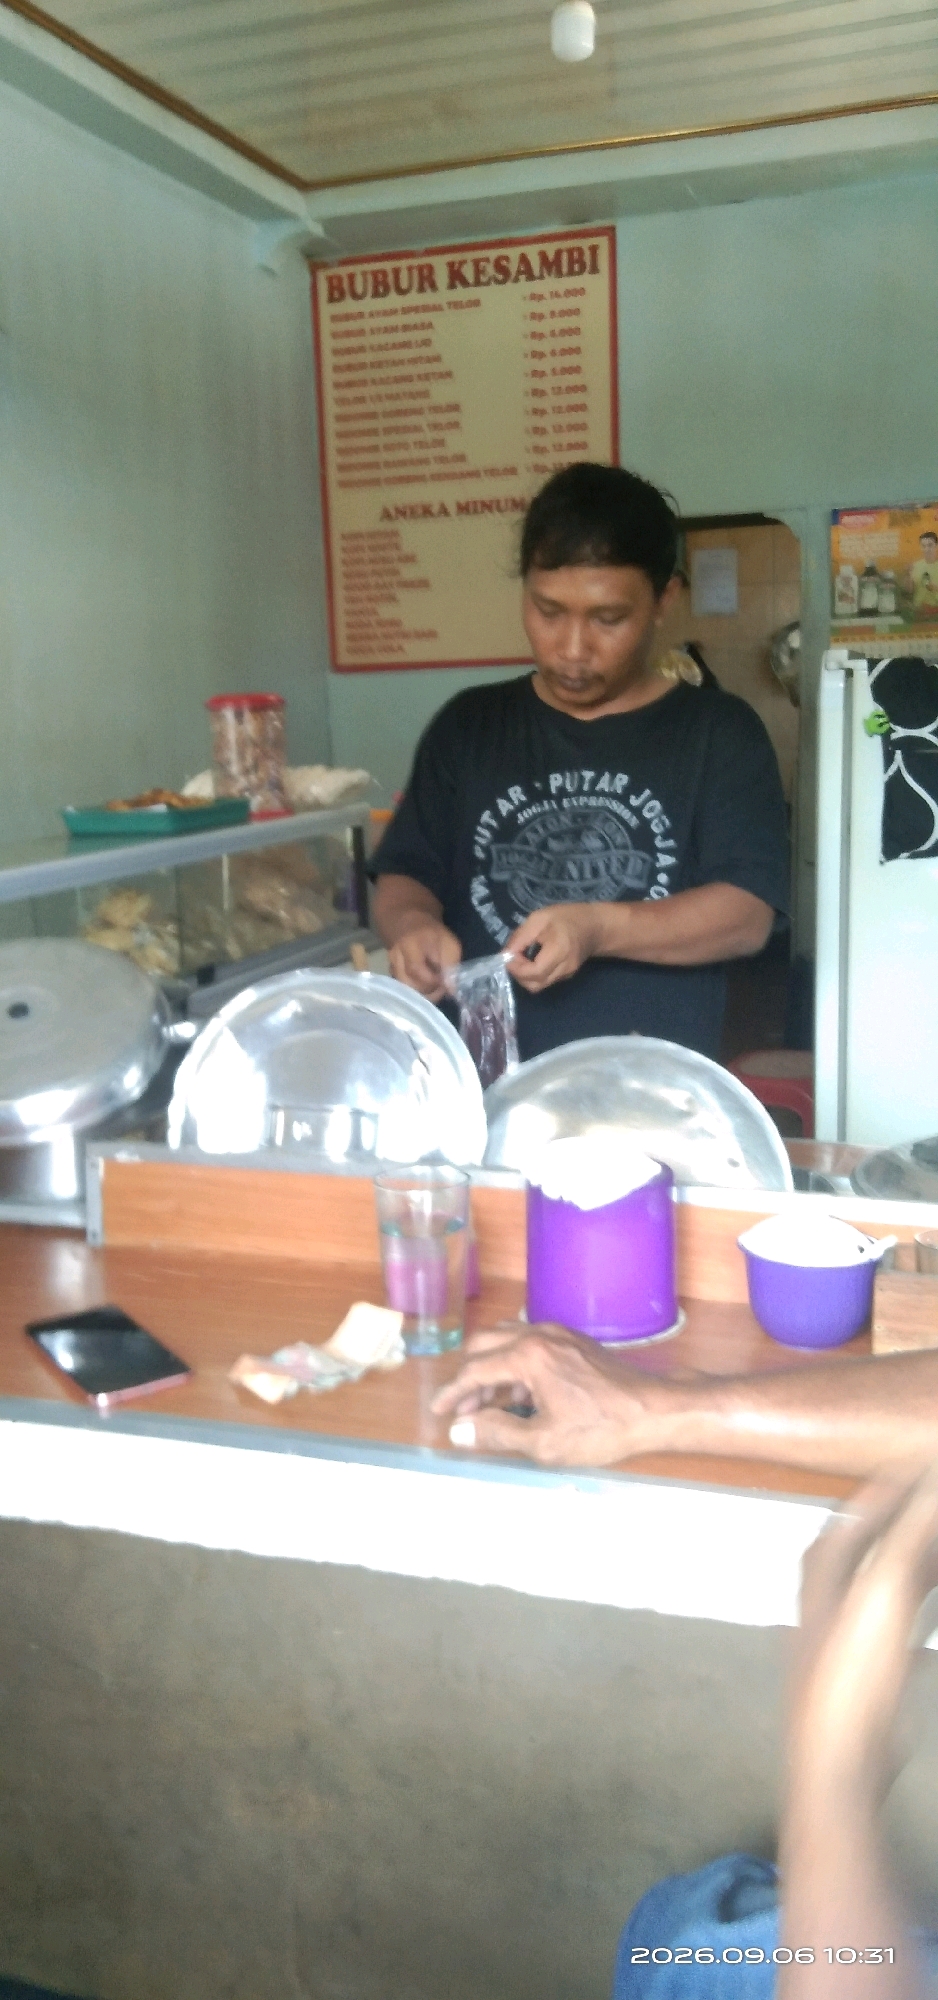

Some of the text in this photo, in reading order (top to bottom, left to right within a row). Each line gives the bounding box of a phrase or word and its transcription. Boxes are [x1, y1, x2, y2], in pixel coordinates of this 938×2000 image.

[327, 245, 600, 303] BUBUR KESAMBI
[381, 498, 529, 521] ANEKA MINUM
[548, 769, 630, 795] PUTAR
[629, 787, 678, 870] JOGJA
